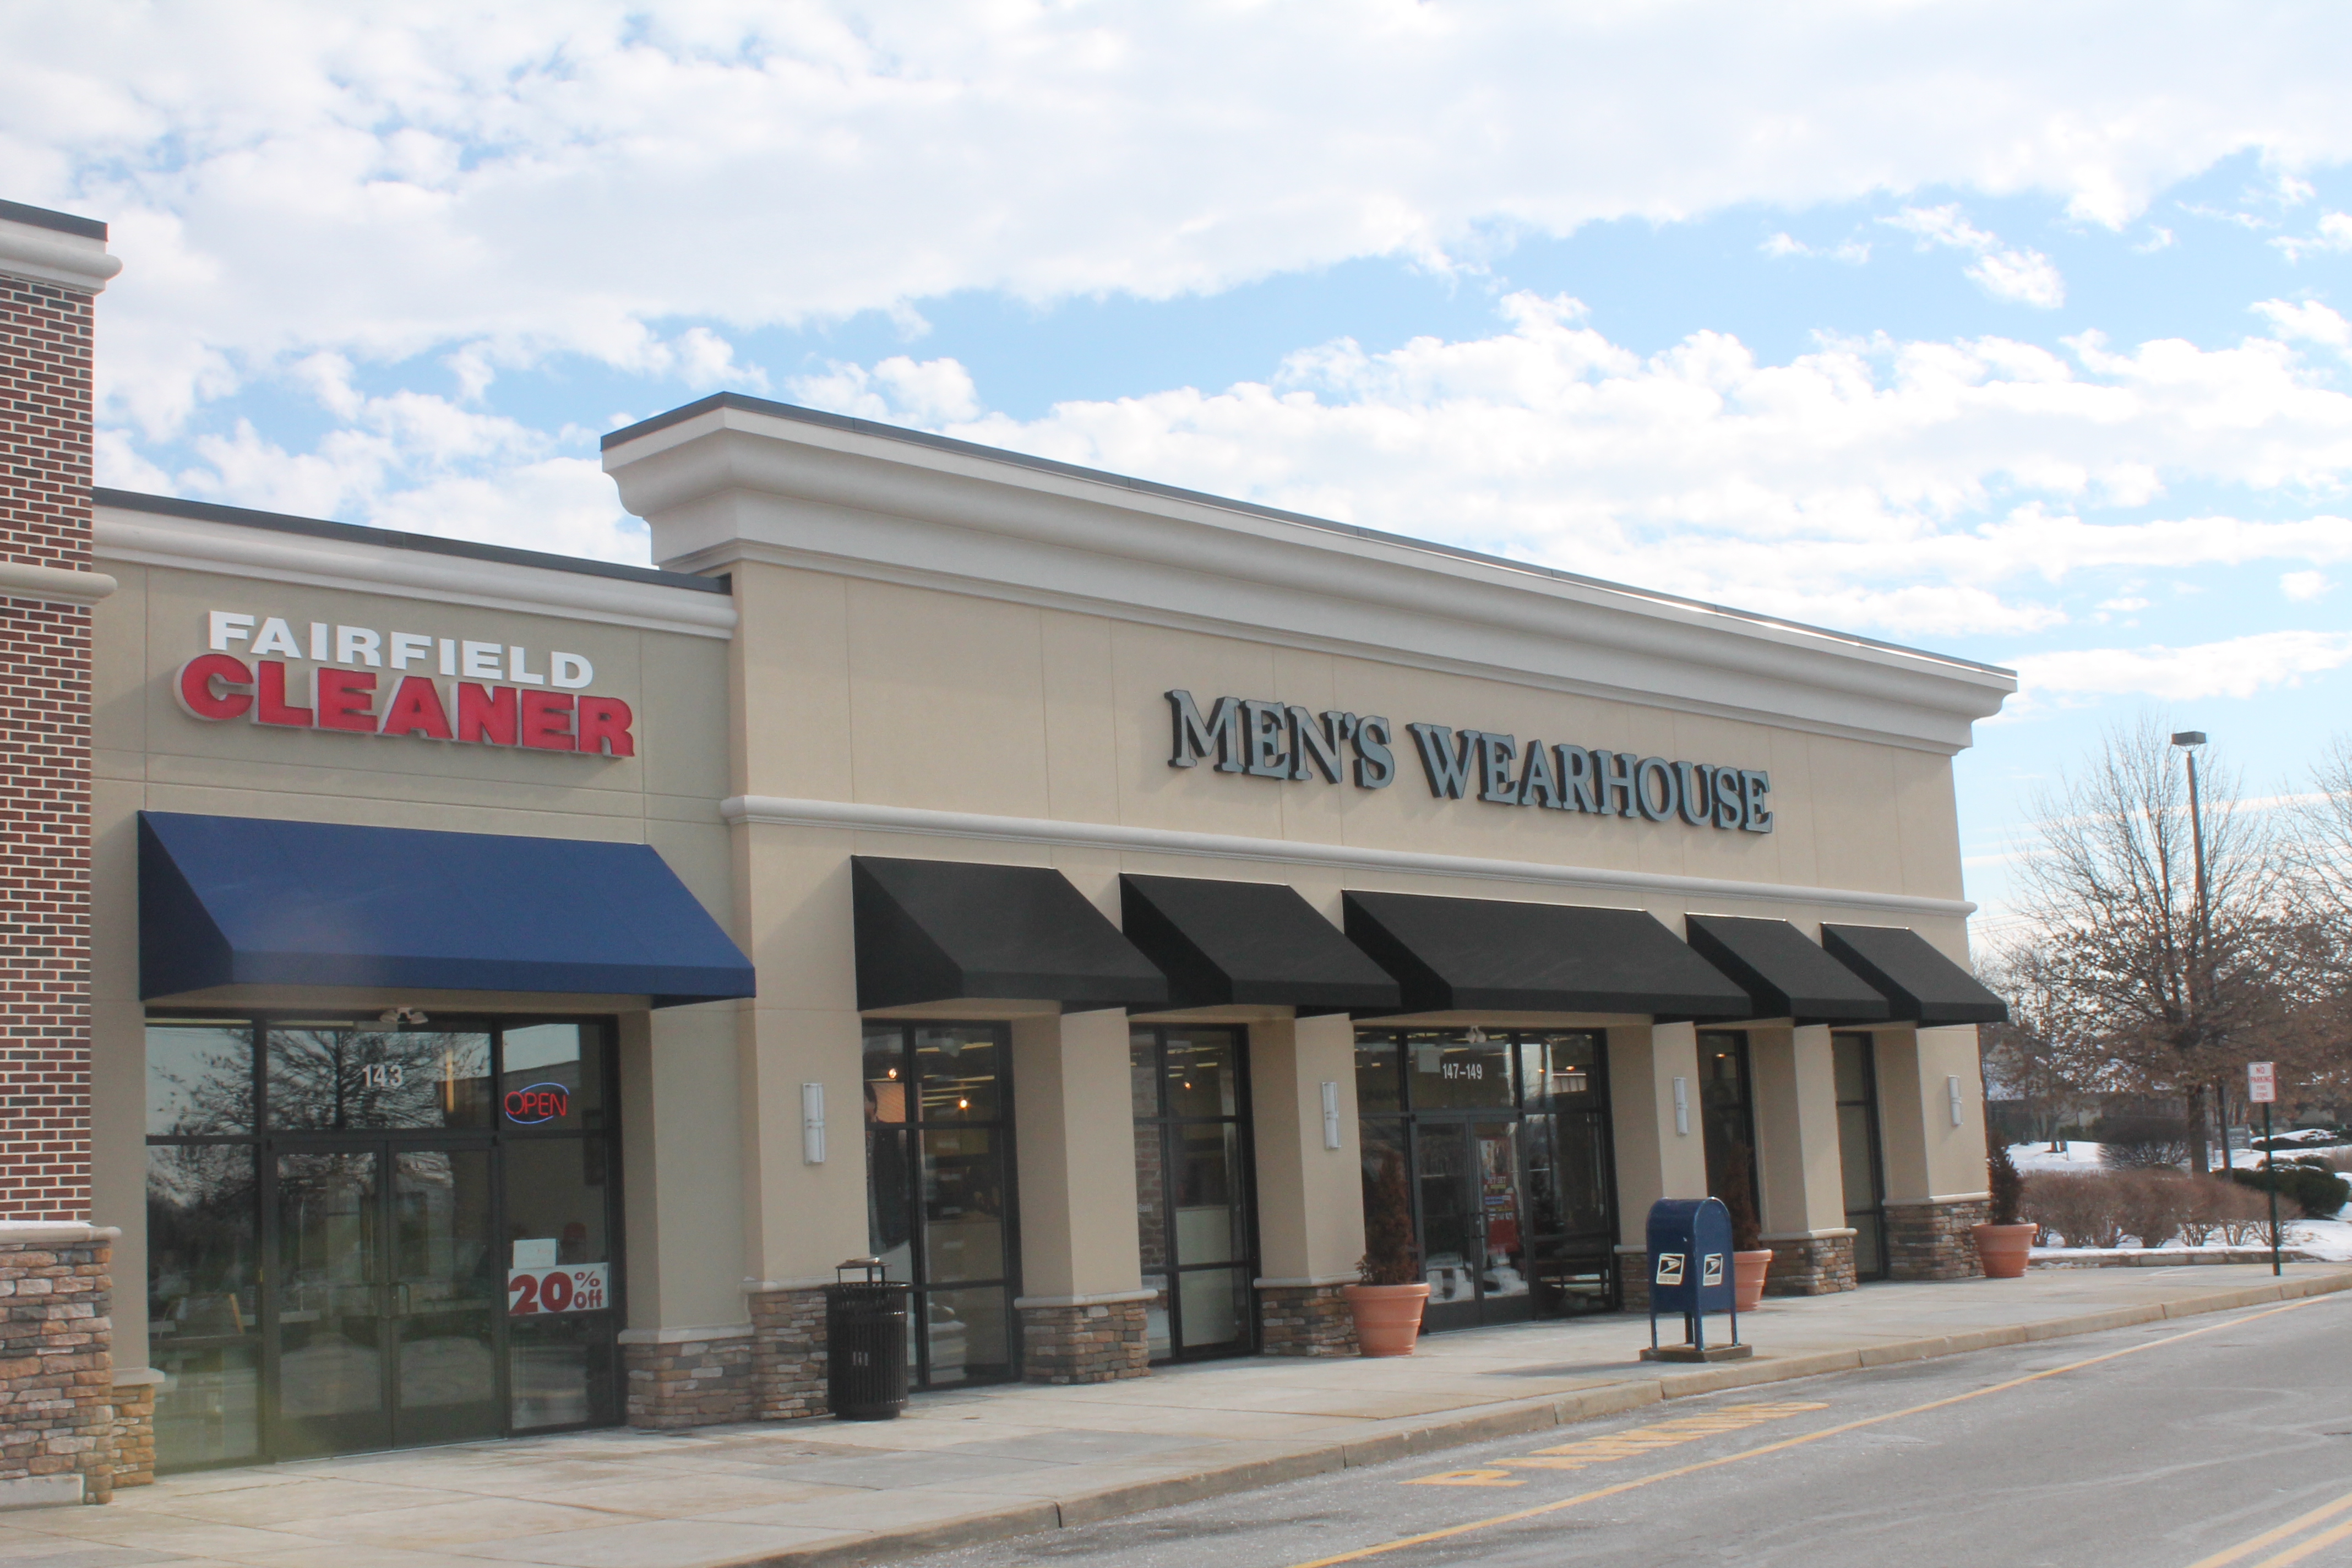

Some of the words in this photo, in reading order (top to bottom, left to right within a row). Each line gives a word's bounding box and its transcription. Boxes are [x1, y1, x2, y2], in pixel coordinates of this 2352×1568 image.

[209, 610, 594, 689] FAIRFIELD
[173, 653, 636, 758] CLEANER
[1163, 689, 1395, 789] MEN'S
[1405, 722, 1773, 834] WEARHOUSE
[362, 1064, 404, 1087] 143
[504, 1091, 567, 1116] OPEN
[1442, 1063, 1483, 1080] 147-149
[1397, 1402, 1831, 1487] PARKING
